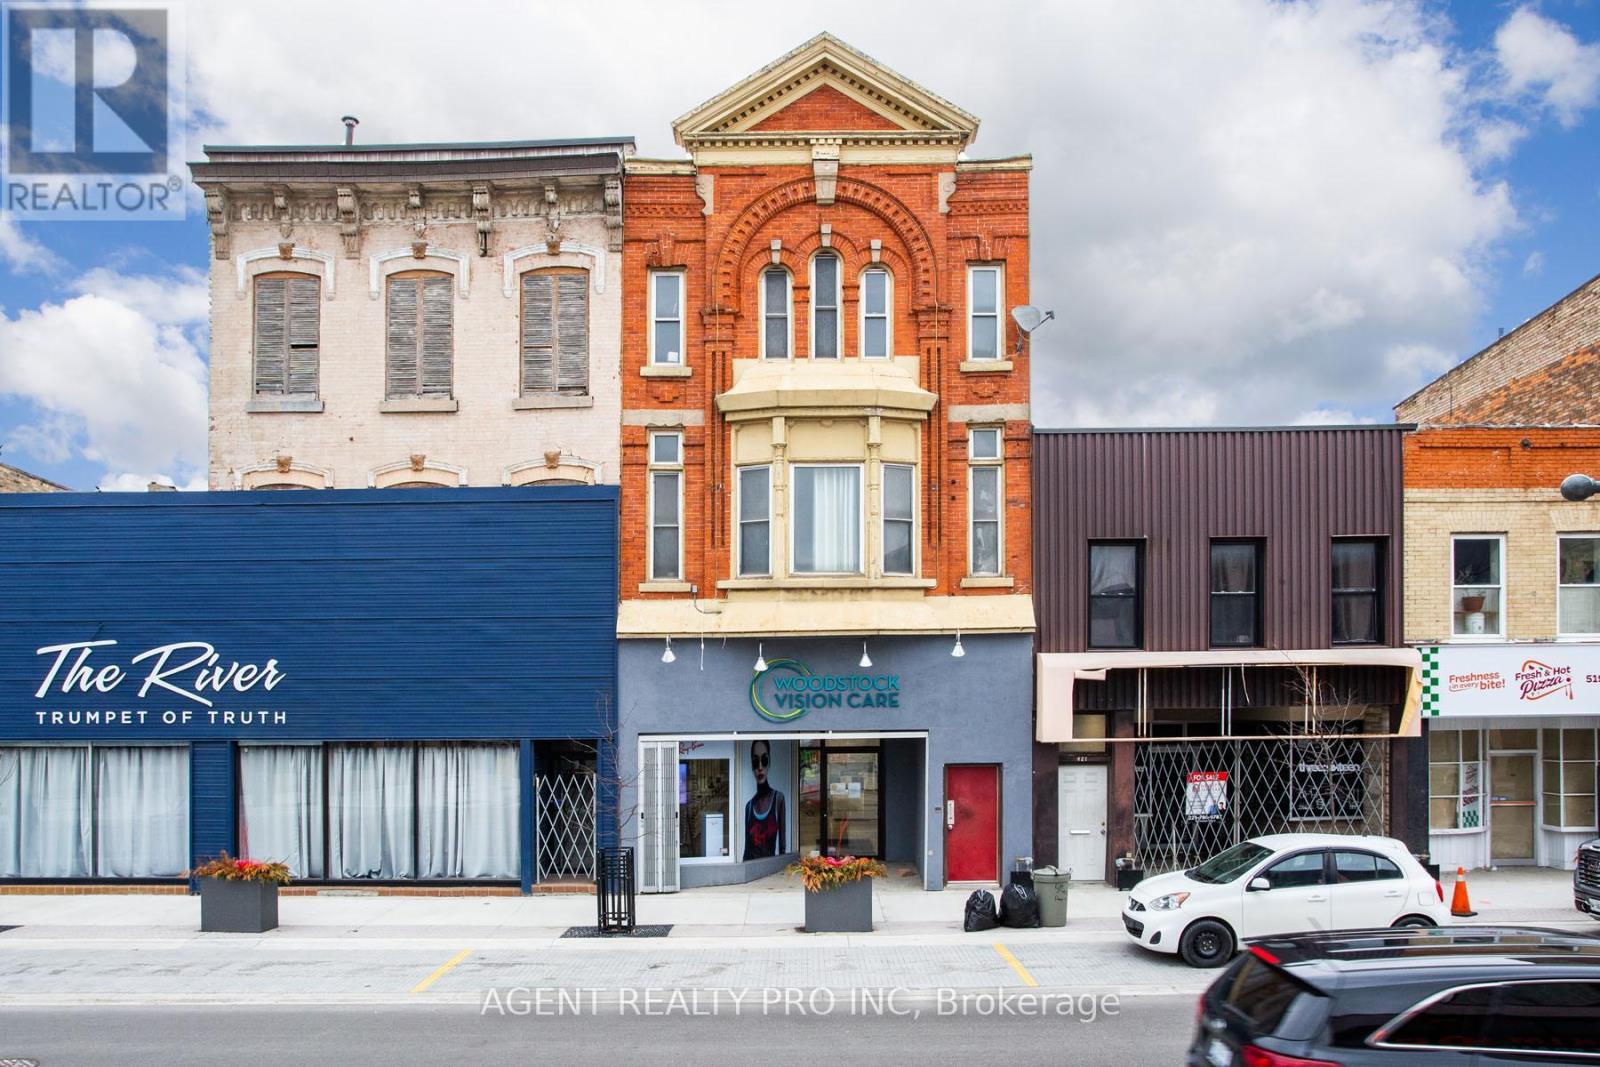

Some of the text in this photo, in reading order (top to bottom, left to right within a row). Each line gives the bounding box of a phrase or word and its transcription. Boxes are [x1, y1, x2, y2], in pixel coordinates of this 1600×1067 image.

[35, 640, 286, 707] The River
[1449, 672, 1500, 683] Freshness
[1515, 670, 1542, 680] Fresh
[1553, 666, 1571, 675] Hot
[774, 675, 900, 692] WOODSTOCK
[1460, 681, 1479, 689] every
[1480, 678, 1505, 690] bite!
[1520, 676, 1562, 700] Pizza
[774, 692, 900, 709] VISION CARE
[36, 711, 286, 724] TRUMPET OF TRUTH
